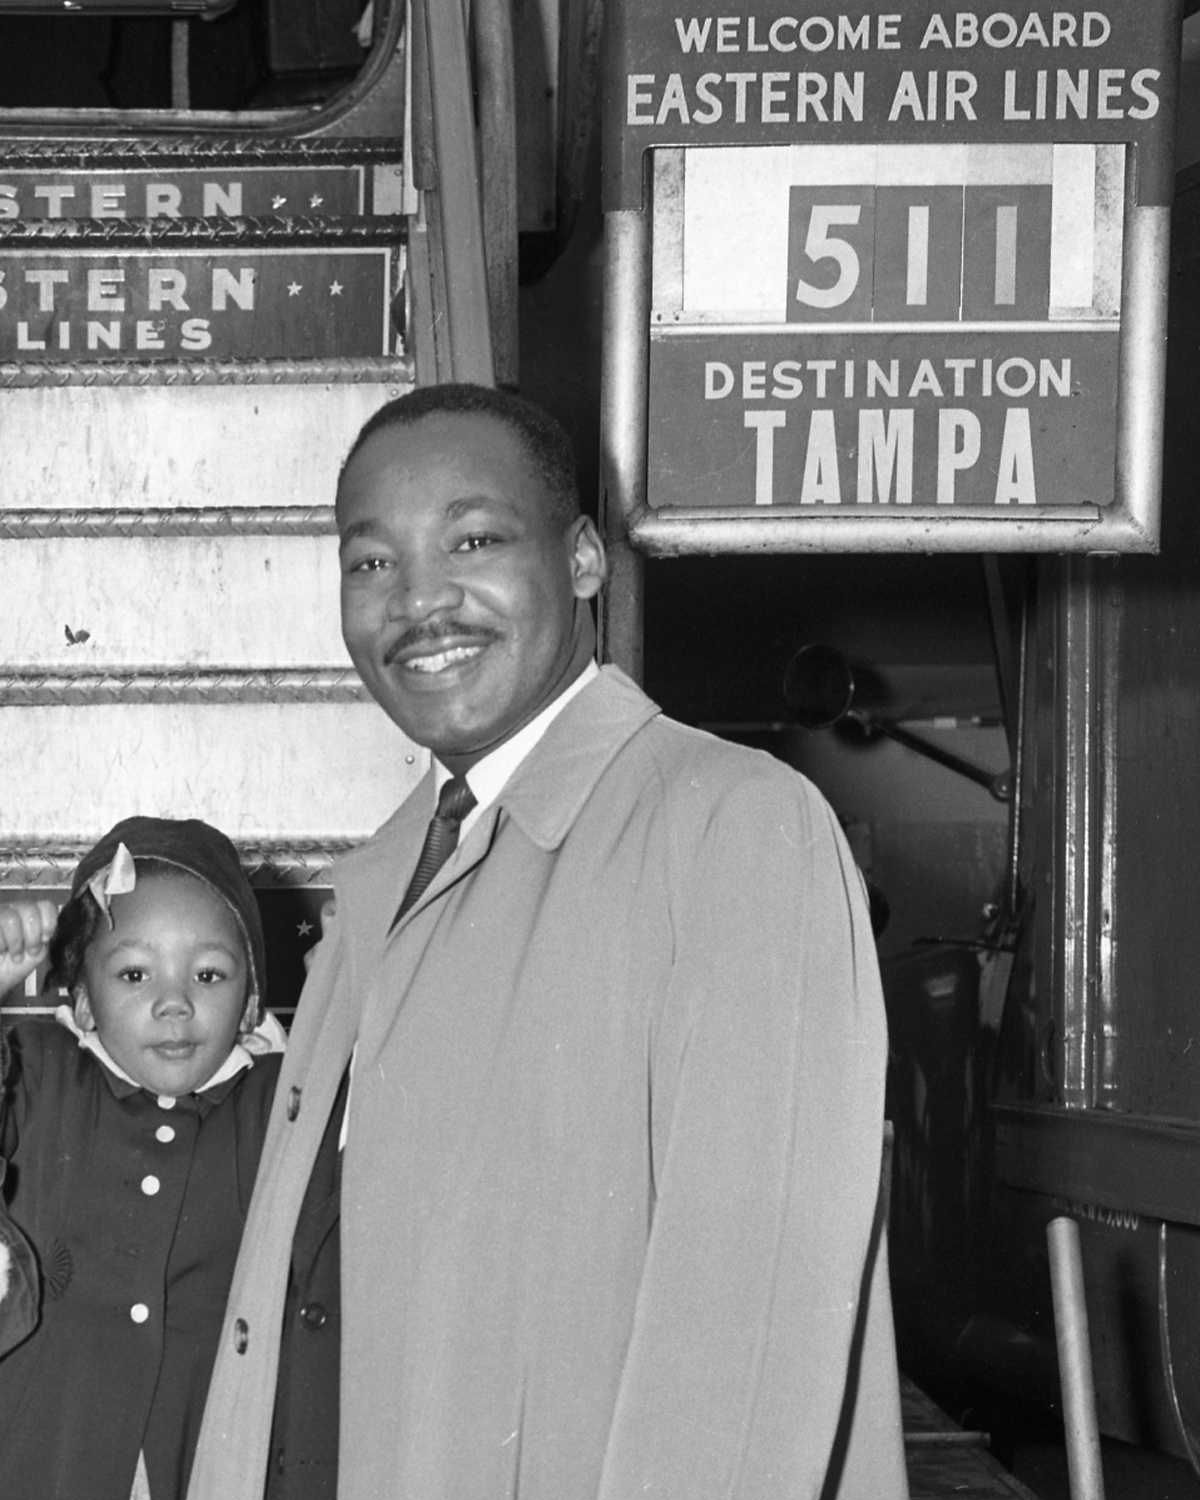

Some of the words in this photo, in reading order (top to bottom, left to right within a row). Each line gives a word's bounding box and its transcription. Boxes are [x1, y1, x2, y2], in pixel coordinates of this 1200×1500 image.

[675, 15, 901, 53] WELCOME
[919, 12, 1111, 50] ABOARD
[627, 72, 864, 125] EASTERN
[888, 71, 978, 121] AIR
[1004, 69, 1161, 120] LINES
[796, 205, 1017, 308] 511
[17, 318, 212, 351] LINES
[705, 357, 1072, 399] DESTINATION
[744, 408, 1037, 504] TAMPA
